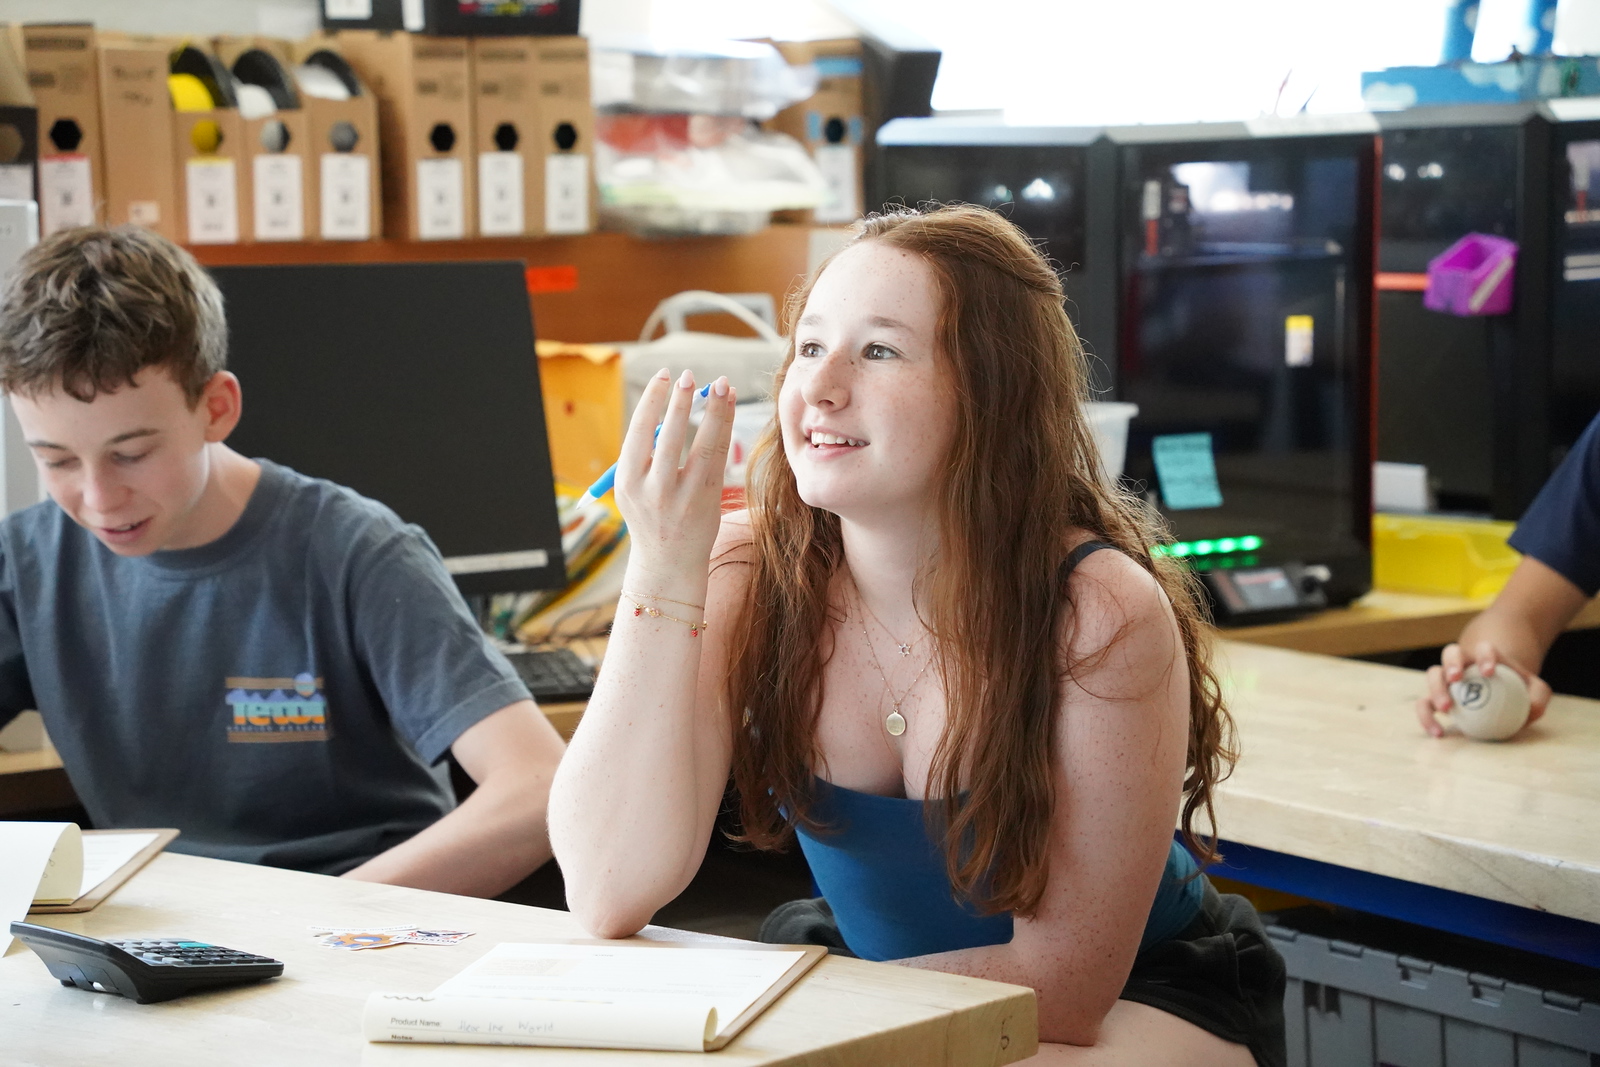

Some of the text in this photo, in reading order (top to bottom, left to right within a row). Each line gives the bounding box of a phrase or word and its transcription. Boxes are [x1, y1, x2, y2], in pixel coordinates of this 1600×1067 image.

[391, 1017, 441, 1027] Product Name:
[518, 1021, 554, 1033] World
